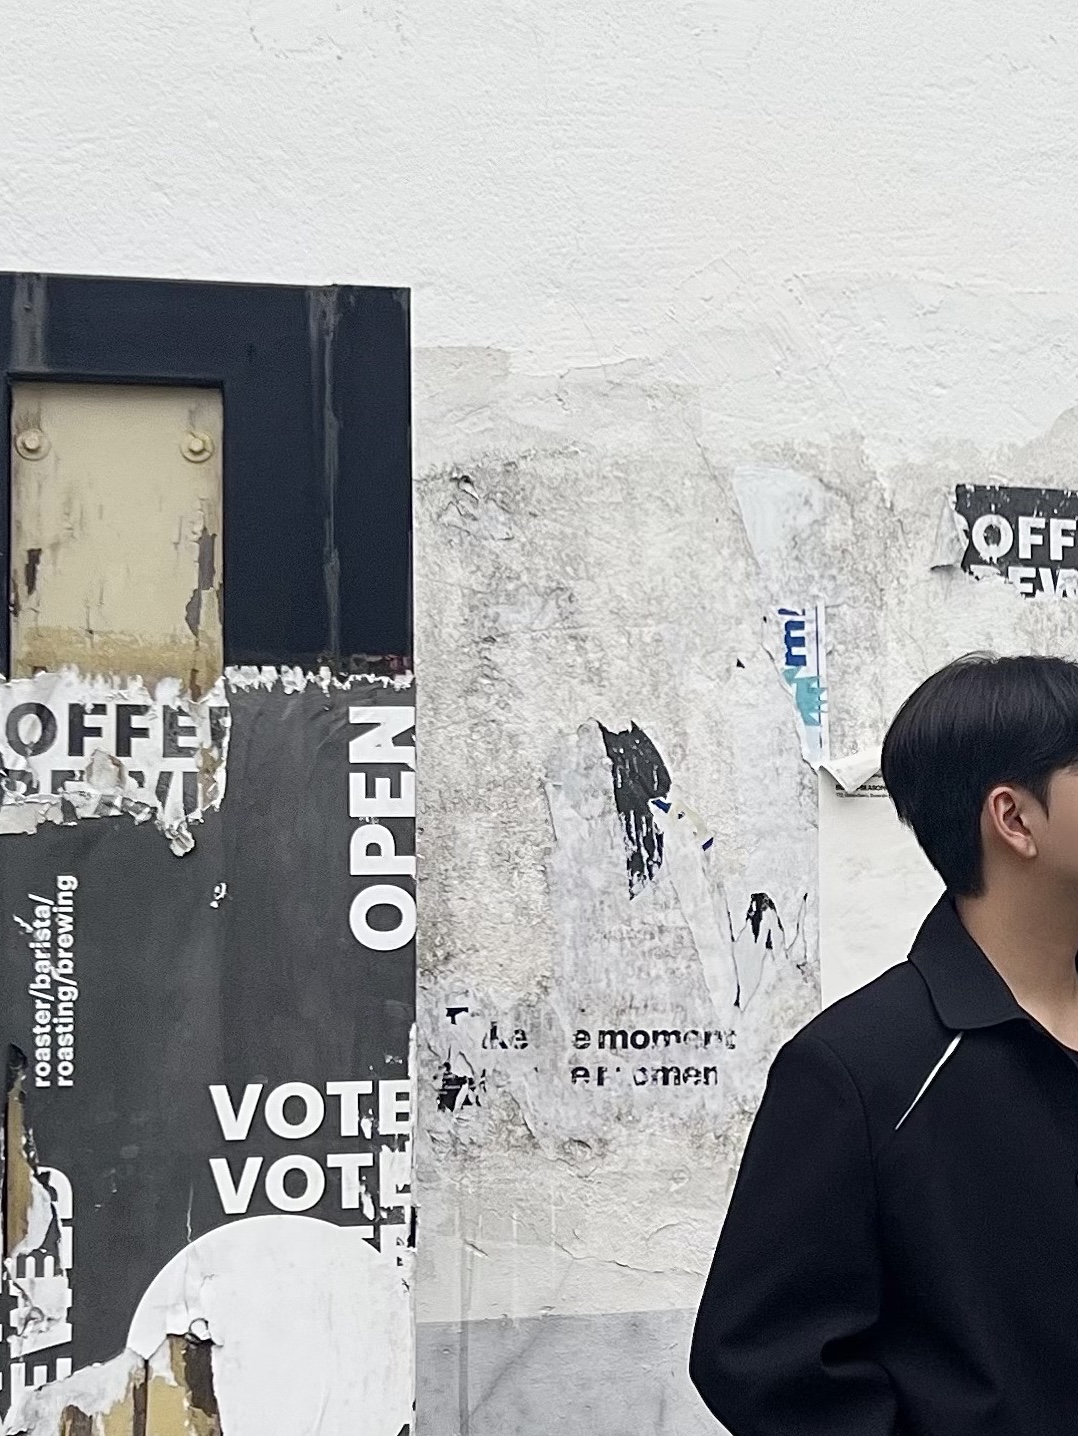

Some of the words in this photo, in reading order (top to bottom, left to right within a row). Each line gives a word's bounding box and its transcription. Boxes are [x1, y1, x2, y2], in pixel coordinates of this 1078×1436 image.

[348, 706, 417, 951] OPEN
[28, 893, 55, 1087] roaster/barista/
[52, 875, 78, 1087] roasting/brewing
[208, 1080, 413, 1142] VOTE
[208, 1152, 413, 1215] VOTE
